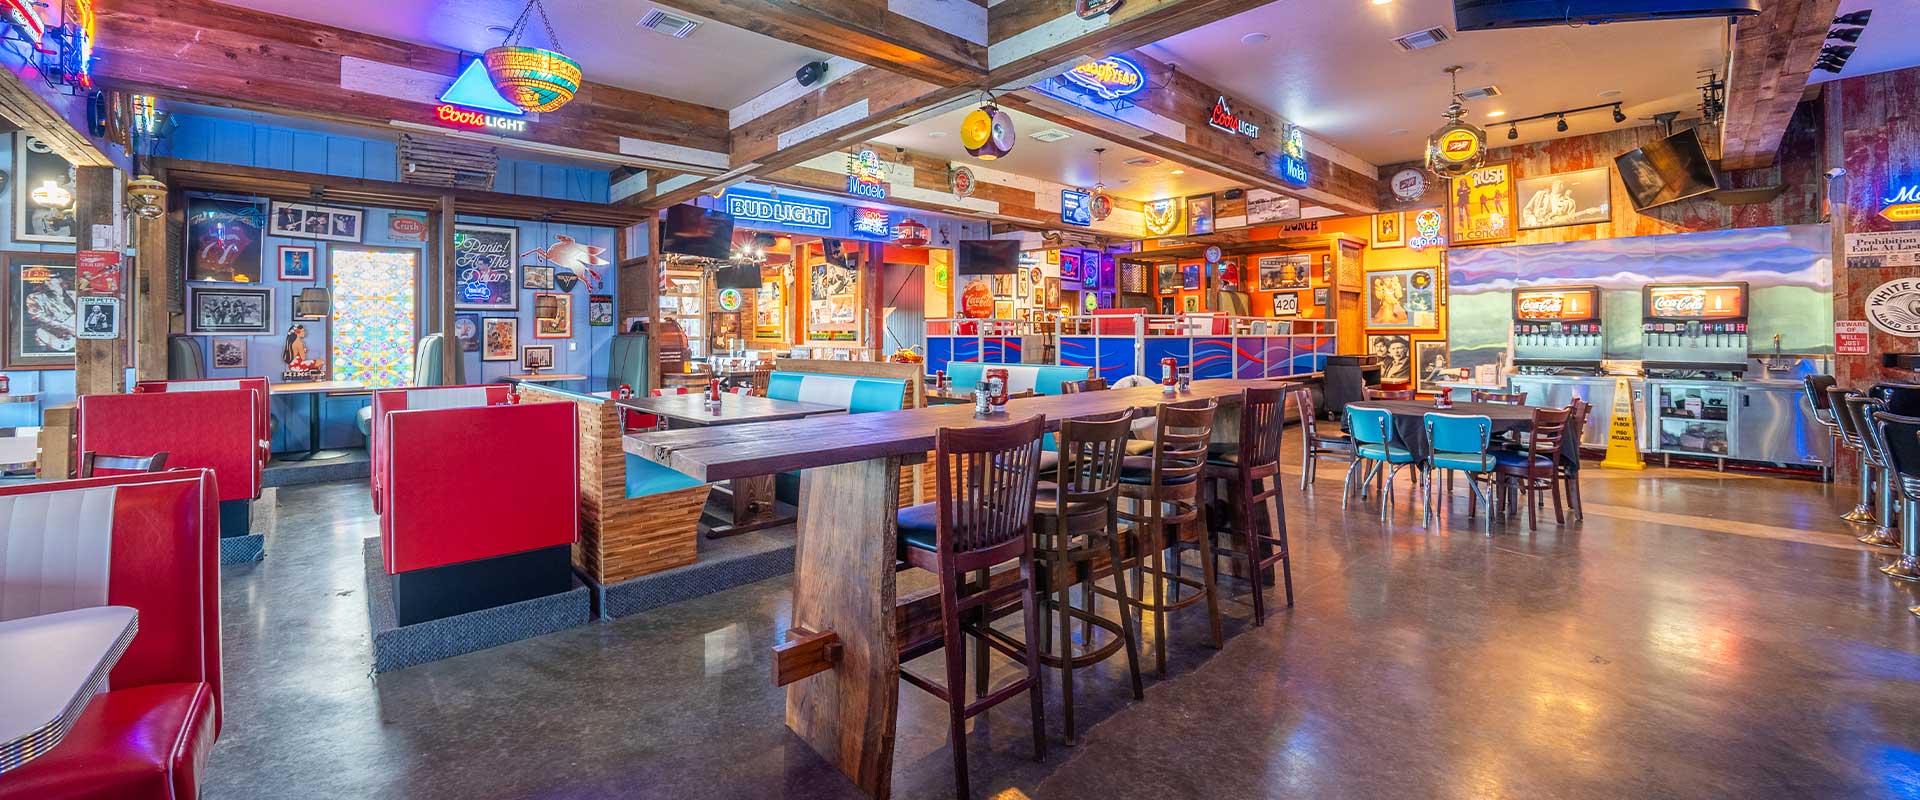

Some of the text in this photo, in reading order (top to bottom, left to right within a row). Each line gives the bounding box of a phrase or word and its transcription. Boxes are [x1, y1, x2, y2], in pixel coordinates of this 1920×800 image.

[437, 104, 526, 131] Coors LIGHT
[1213, 104, 1259, 138] Coors LIGHT
[1287, 157, 1307, 182] Modelo
[1472, 168, 1505, 188] RUSH
[849, 175, 886, 199] Modelo
[731, 198, 828, 225] BUD LIGHT
[461, 237, 511, 253] Panic!
[1856, 238, 1916, 246] Prohibition
[486, 253, 510, 270] The
[1276, 300, 1295, 310] 420
[1872, 282, 1911, 306] WHITE
[1878, 313, 1901, 329] HARD
